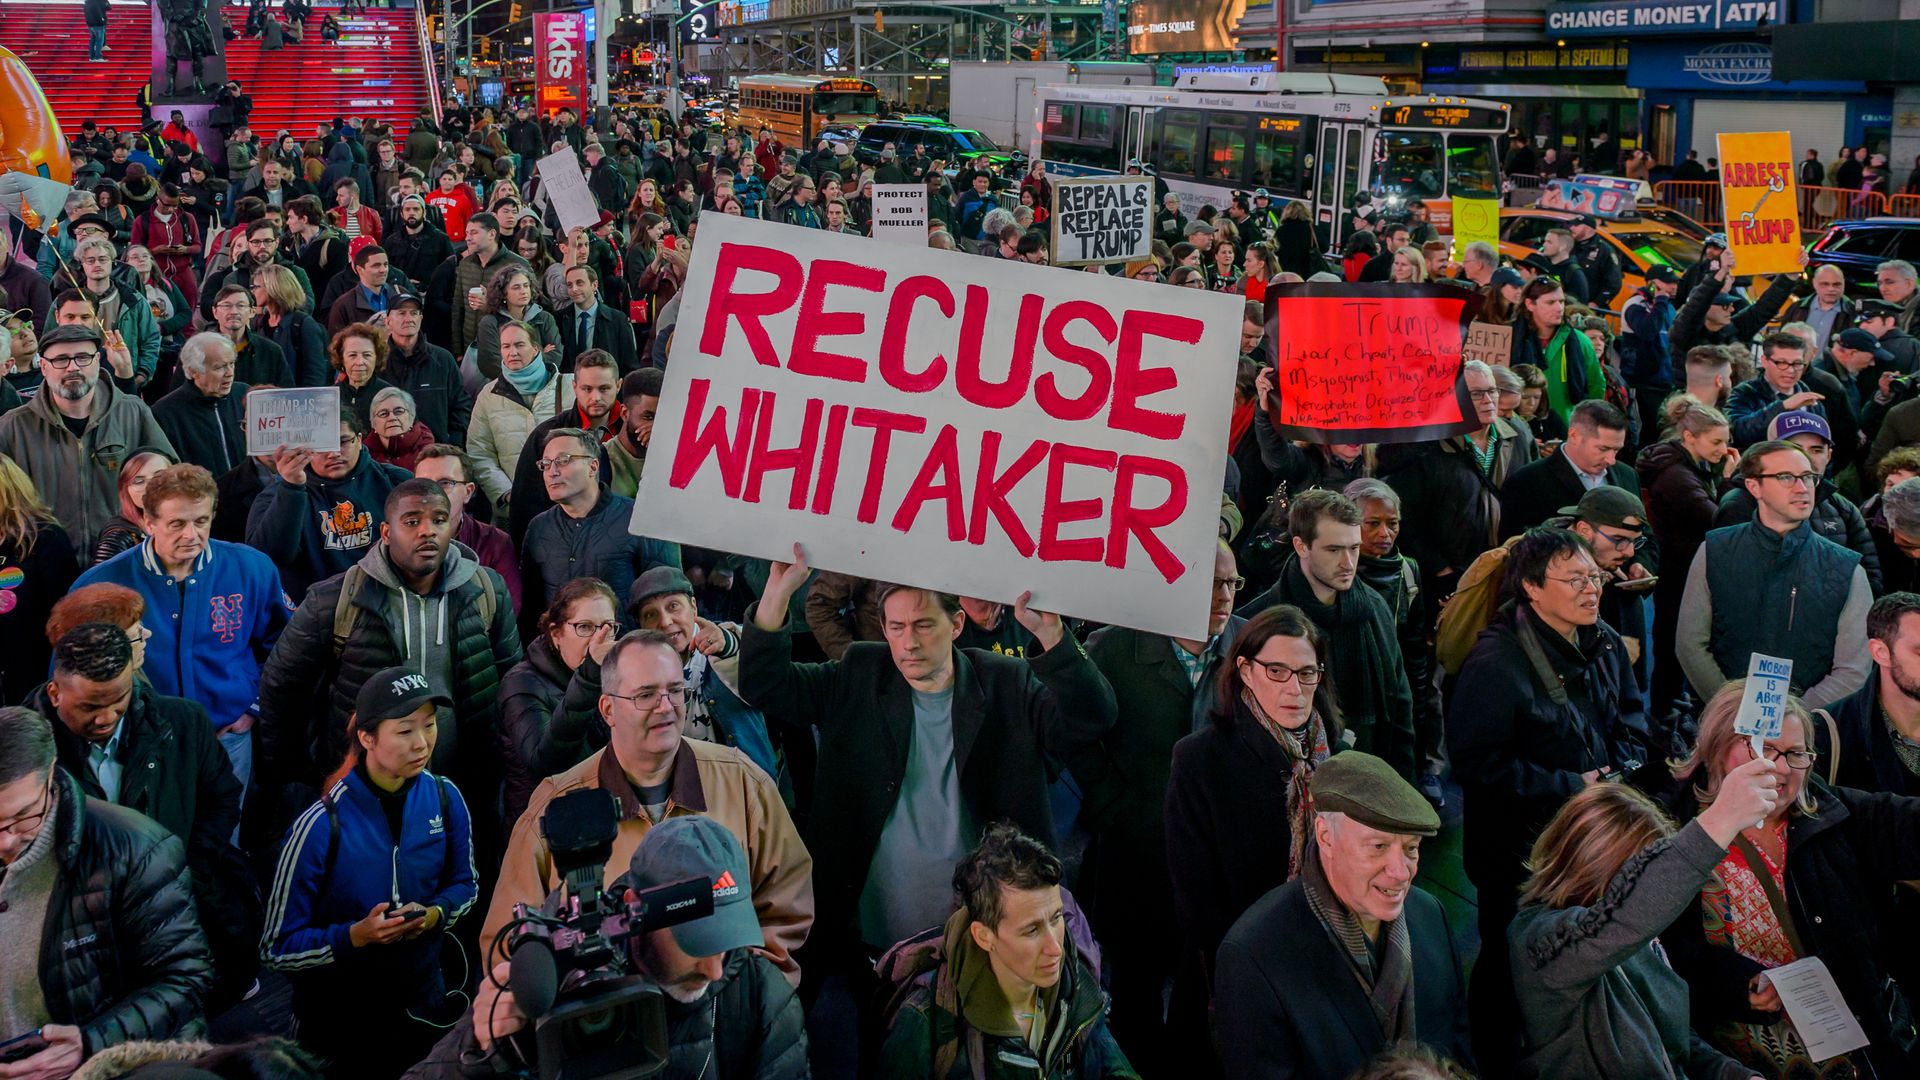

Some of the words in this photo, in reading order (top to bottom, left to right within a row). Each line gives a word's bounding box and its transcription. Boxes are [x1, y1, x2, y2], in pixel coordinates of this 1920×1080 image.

[1550, 9, 1628, 29] CHANGE
[1634, 5, 1711, 27] MONEY
[1725, 2, 1777, 22] ATM
[1149, 22, 1167, 33] TIMES
[1168, 20, 1195, 33] SQUARE
[547, 19, 579, 80] tkts
[1684, 57, 1726, 69] MONEY
[1334, 103, 1352, 112] 6775
[1724, 162, 1790, 188] ARREST
[1058, 185, 1132, 213] REPEAL
[1133, 184, 1148, 207] &
[879, 219, 924, 227] MUELLER
[1061, 208, 1144, 235] REPLACE
[1730, 218, 1795, 246] TRUMP
[1075, 229, 1142, 259] TRUMP
[699, 242, 1204, 440] RECUSE
[258, 399, 299, 414] TRUMP
[304, 398, 315, 411] IS
[287, 414, 328, 428] ABOVE
[1802, 418, 1821, 428] NYU
[257, 431, 282, 446] THE
[669, 378, 1188, 584] WHITAKER
[1759, 659, 1791, 676] NOBODY
[1766, 679, 1777, 691] IS
[1755, 691, 1782, 705] ABOVE
[1760, 705, 1777, 718] THE
